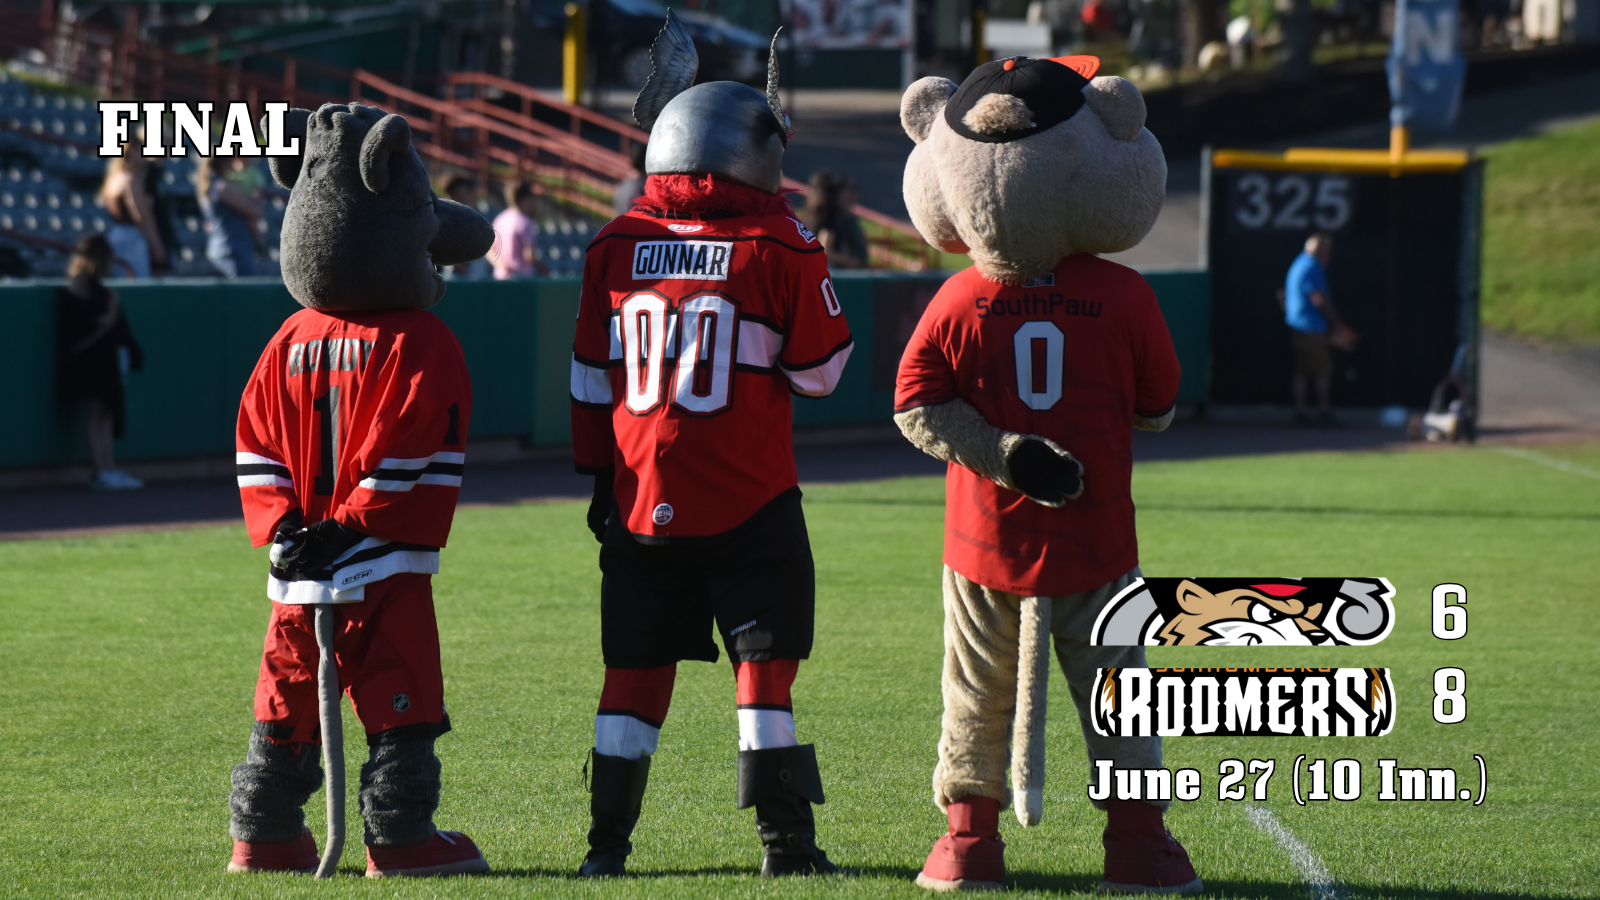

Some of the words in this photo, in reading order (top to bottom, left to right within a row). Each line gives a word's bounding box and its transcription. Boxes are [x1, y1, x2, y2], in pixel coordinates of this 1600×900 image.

[1236, 174, 1350, 229] 325
[635, 243, 727, 276] GUNNAR
[975, 293, 1103, 318] SouthPaw
[620, 289, 742, 417] 00
[1013, 320, 1065, 411] 0
[313, 386, 340, 496] 1
[443, 402, 460, 446] 1
